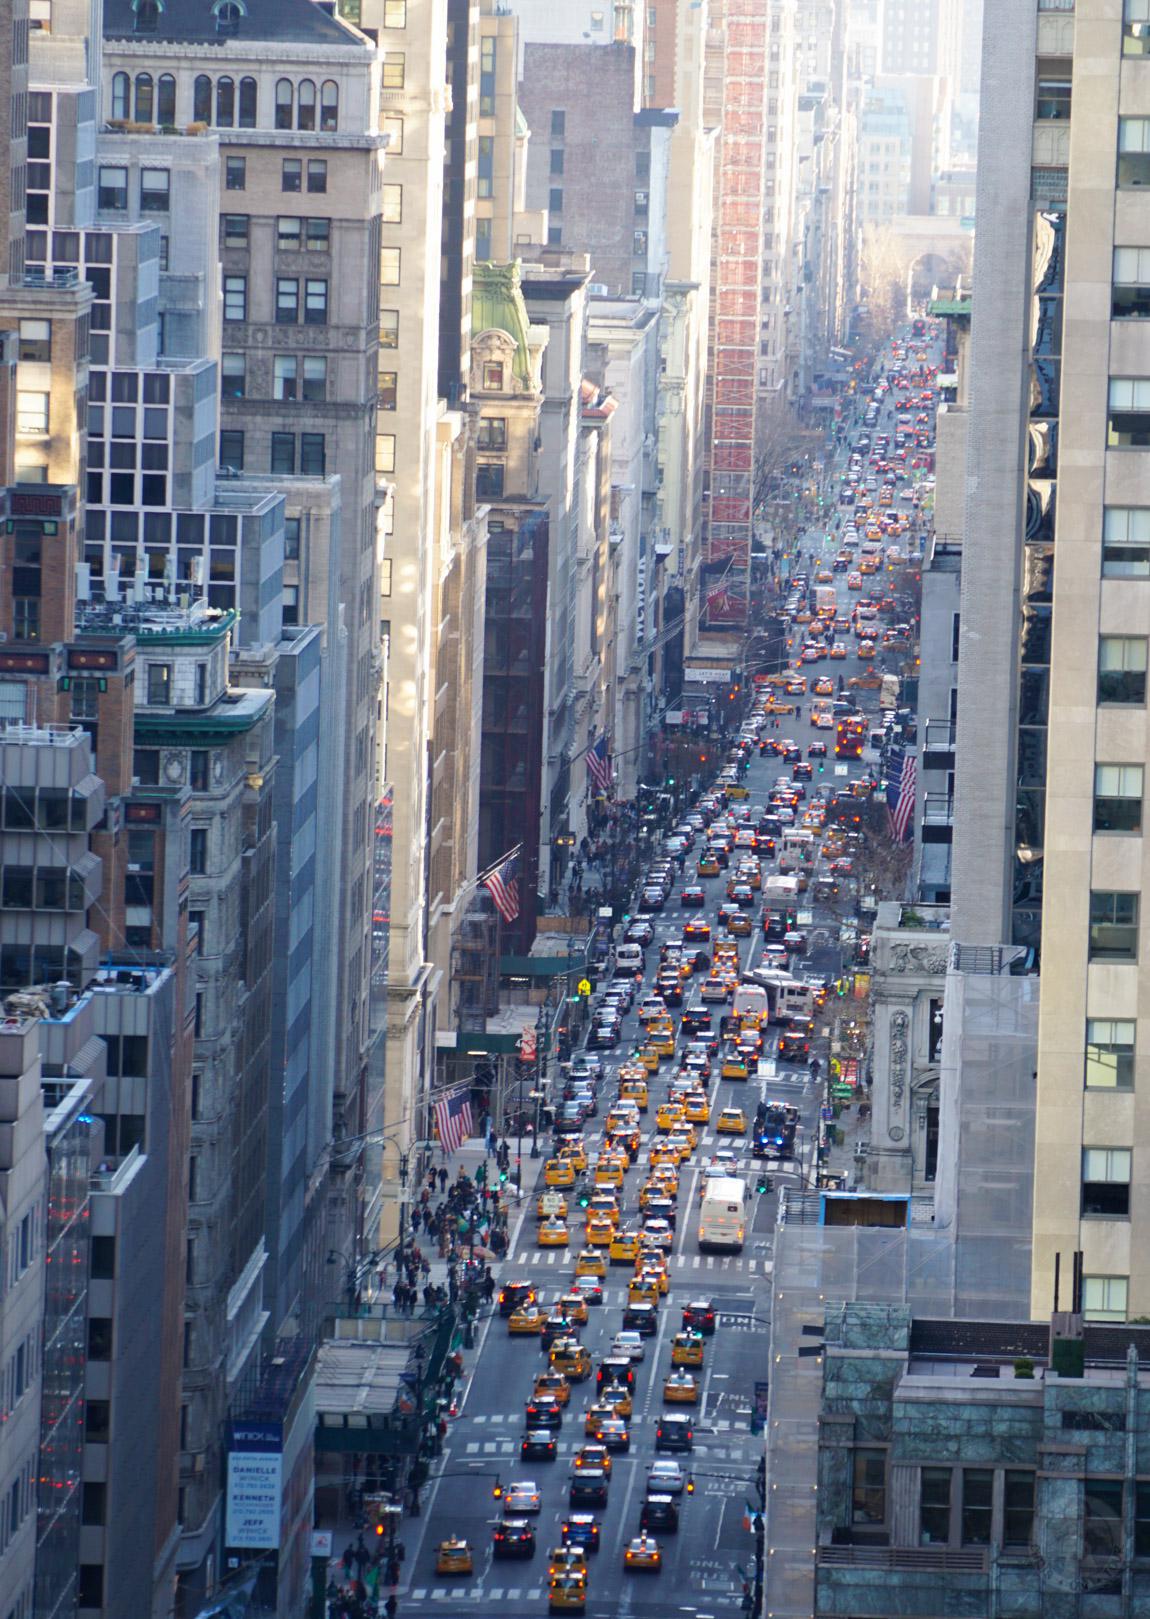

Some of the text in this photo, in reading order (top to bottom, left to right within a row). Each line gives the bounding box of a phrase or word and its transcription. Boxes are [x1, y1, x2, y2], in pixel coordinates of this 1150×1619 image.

[233, 1466, 276, 1474] DANIELLE
[232, 1494, 275, 1502] KENNETH
[689, 1560, 737, 1569] ONLY
